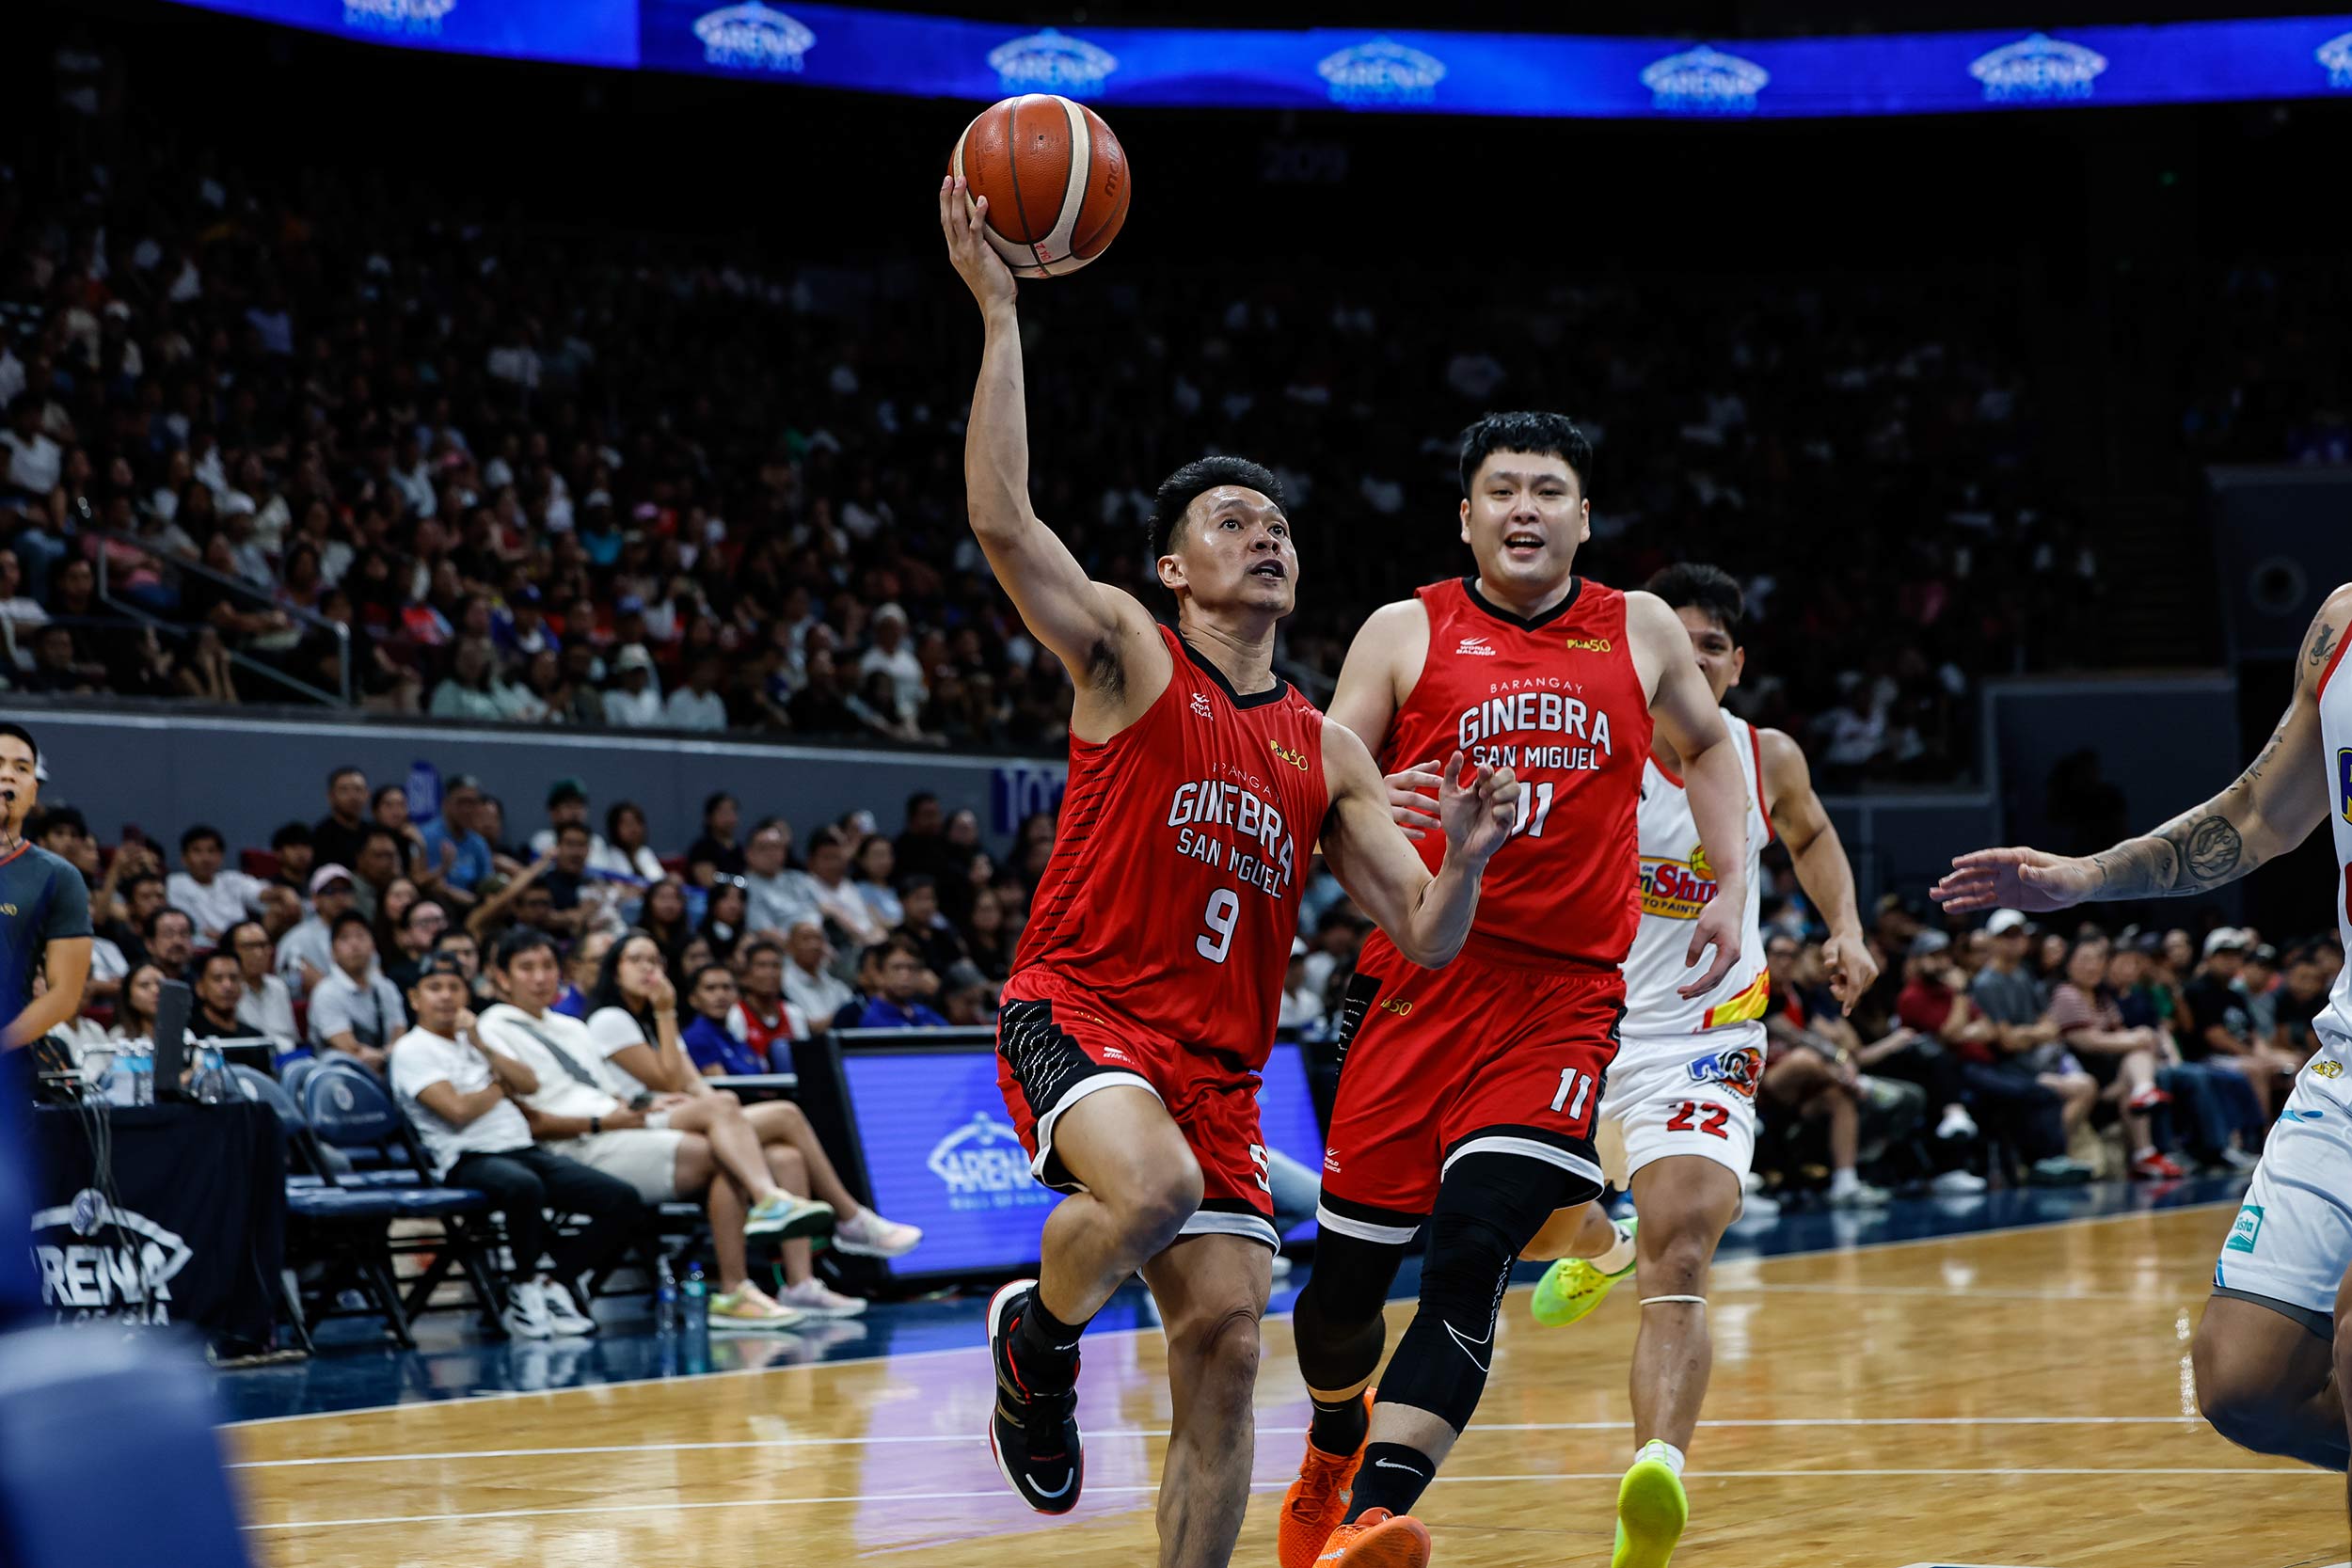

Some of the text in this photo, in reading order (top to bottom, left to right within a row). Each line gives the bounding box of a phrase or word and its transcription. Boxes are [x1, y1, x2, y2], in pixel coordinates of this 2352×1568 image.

[1490, 676, 1583, 694] BARANGAY
[1458, 691, 1612, 756] GINEBRA
[1473, 745, 1601, 770] SAN MIGUEL
[1176, 827, 1222, 867] SAN
[1196, 887, 1240, 964] 9
[1549, 1067, 1593, 1120] 11
[1666, 1100, 1731, 1140] 22
[30, 1243, 172, 1307] RENA
